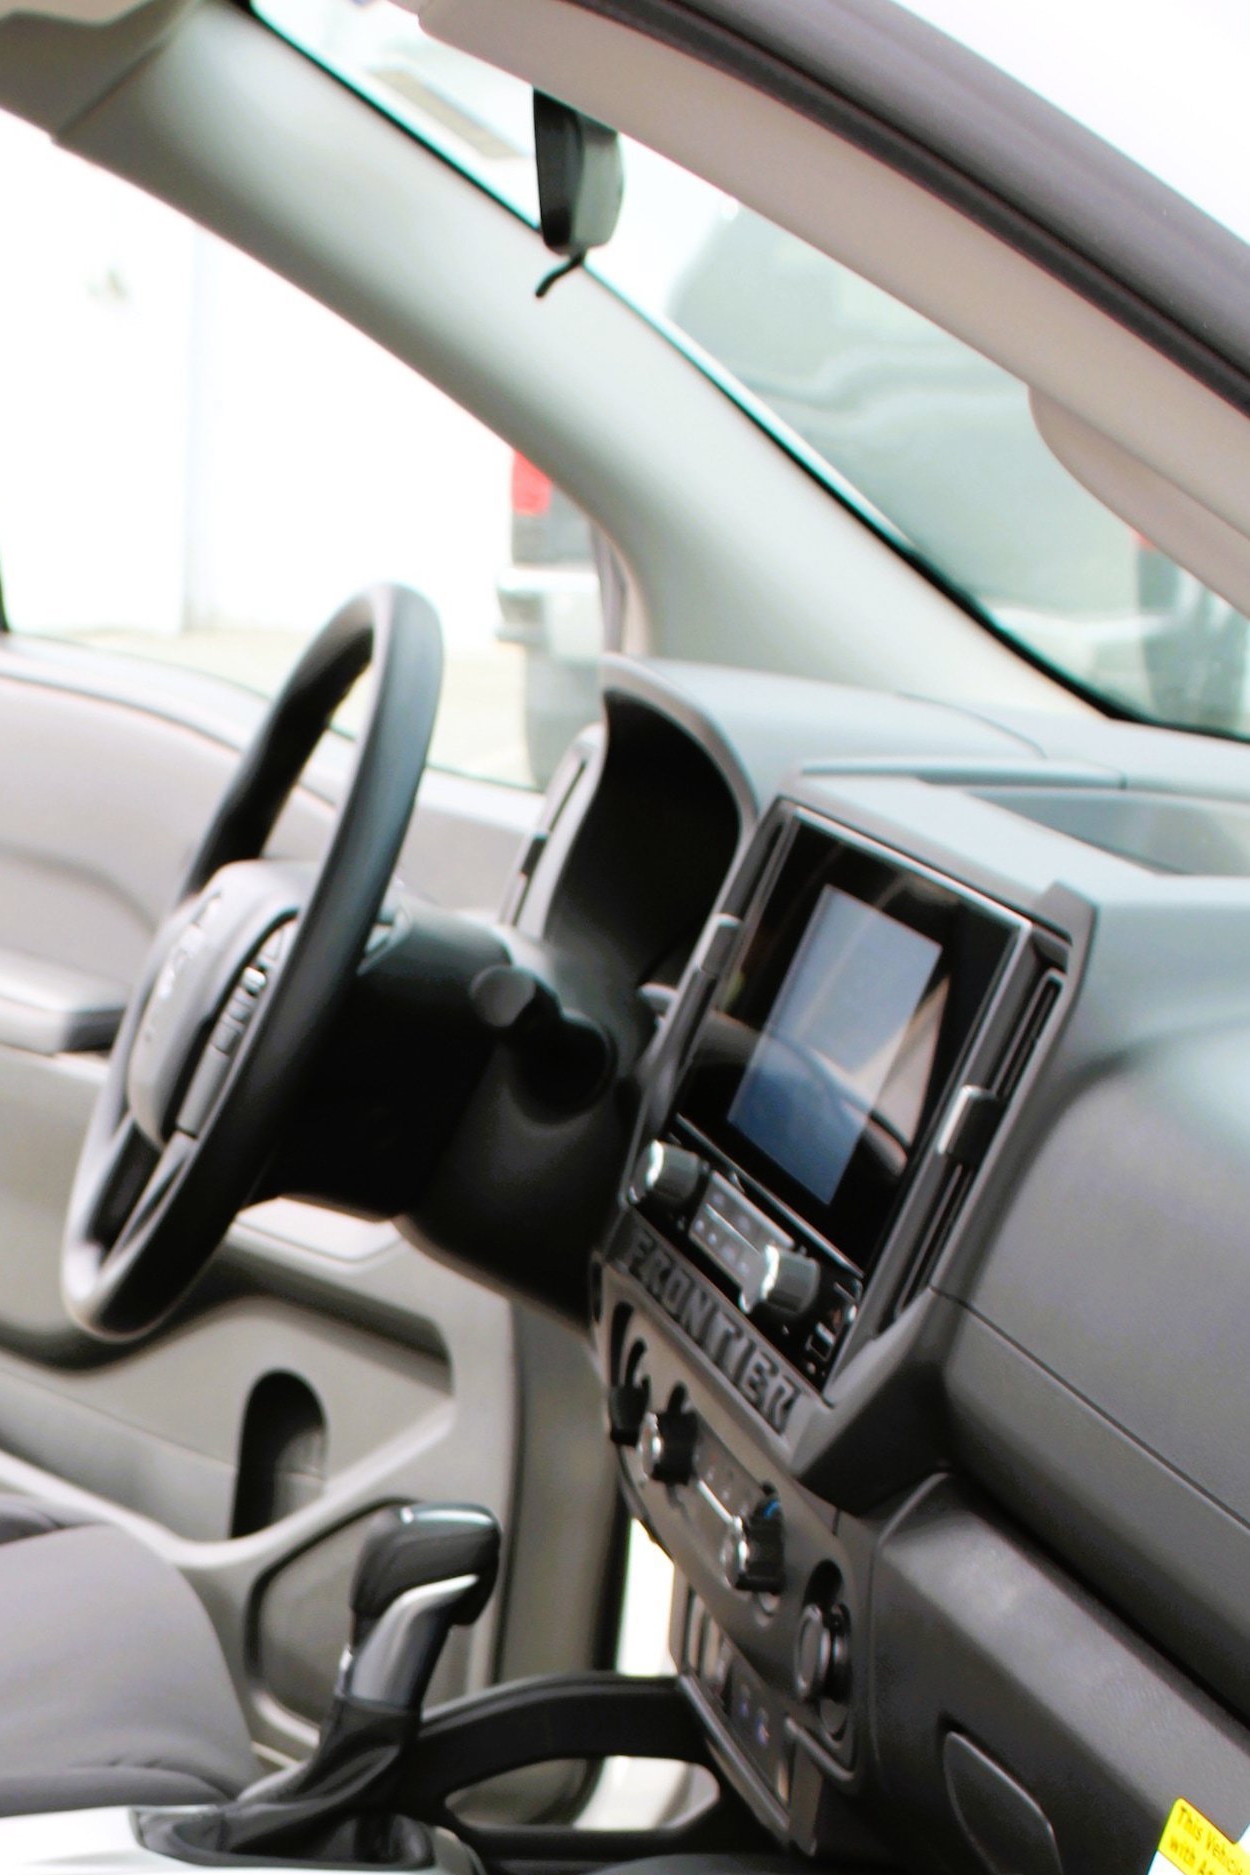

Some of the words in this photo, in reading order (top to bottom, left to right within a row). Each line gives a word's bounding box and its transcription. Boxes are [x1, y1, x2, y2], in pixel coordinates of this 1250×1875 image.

[625, 1229, 803, 1437] FRONTIER
[1177, 1805, 1203, 1842] This
[1169, 1836, 1197, 1868] with
